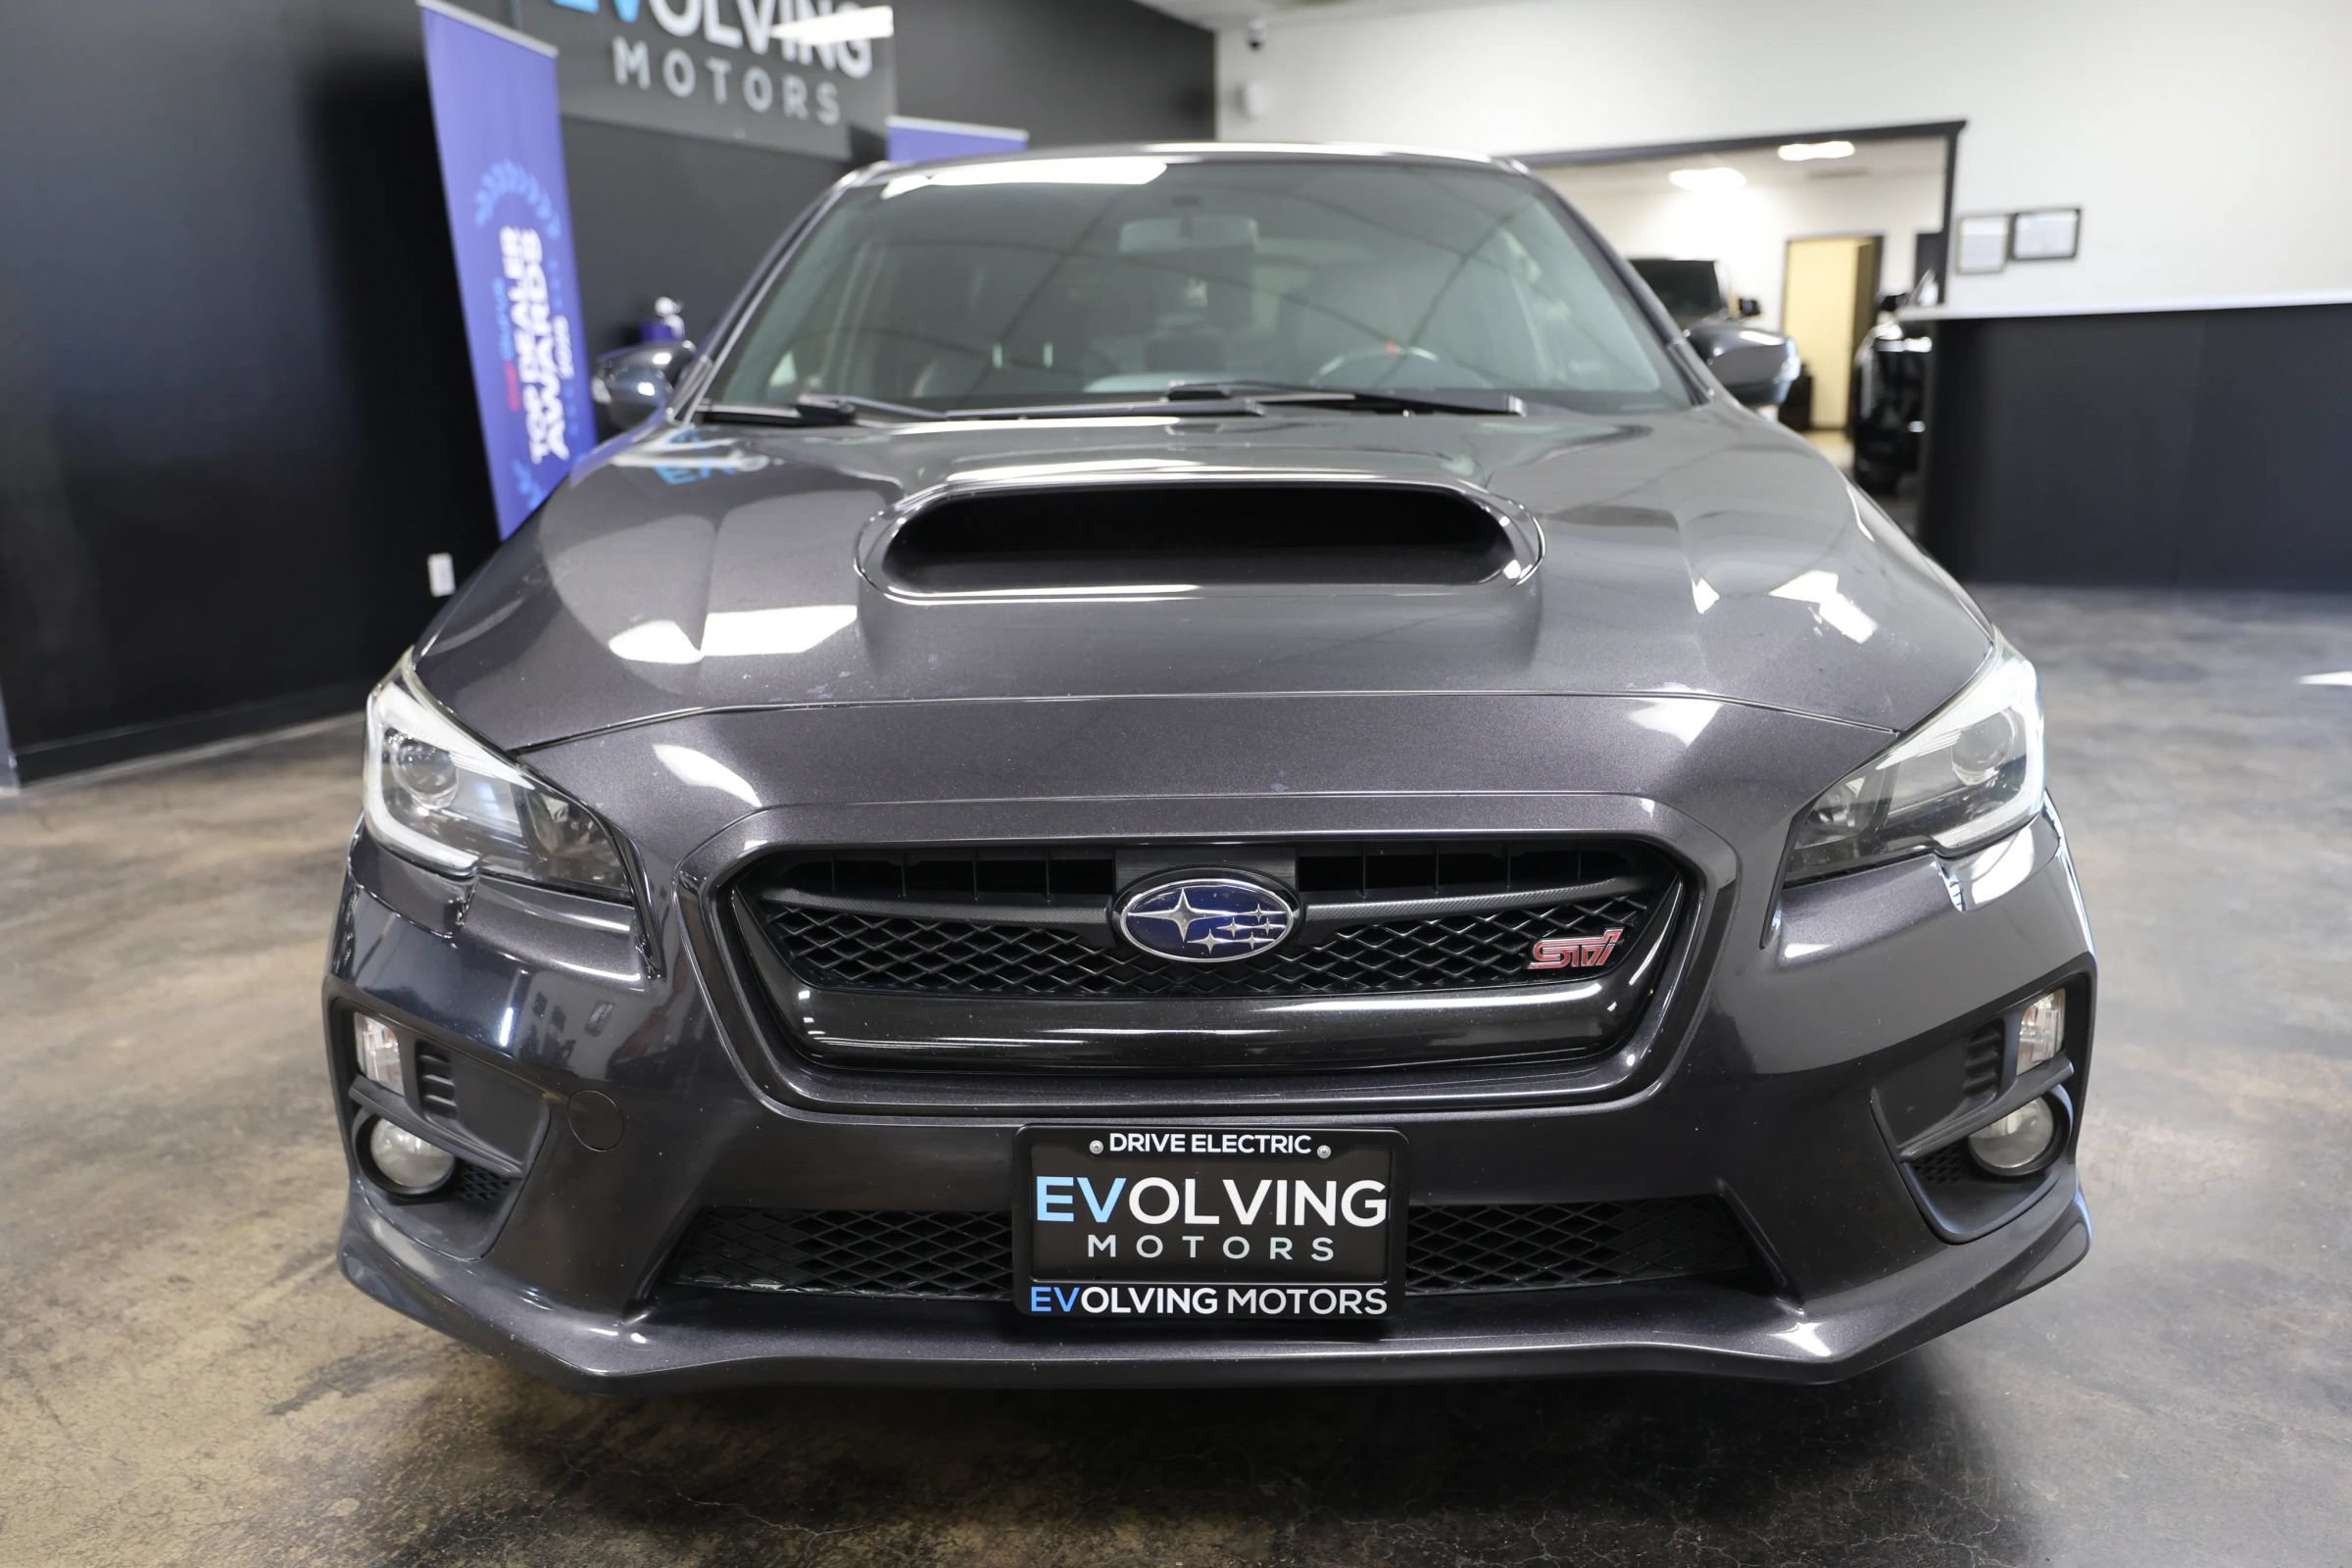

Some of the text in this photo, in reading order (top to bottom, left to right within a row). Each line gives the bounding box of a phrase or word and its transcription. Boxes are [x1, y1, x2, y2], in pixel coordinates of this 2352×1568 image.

[612, 36, 841, 125] MOTORS
[1109, 1133, 1311, 1153] DRIVE ELECTRIC
[1036, 1176, 1387, 1227] EVOLVING
[1087, 1234, 1334, 1261] MOTORS
[1030, 1286, 1388, 1315] EVOLVING MOTORS
